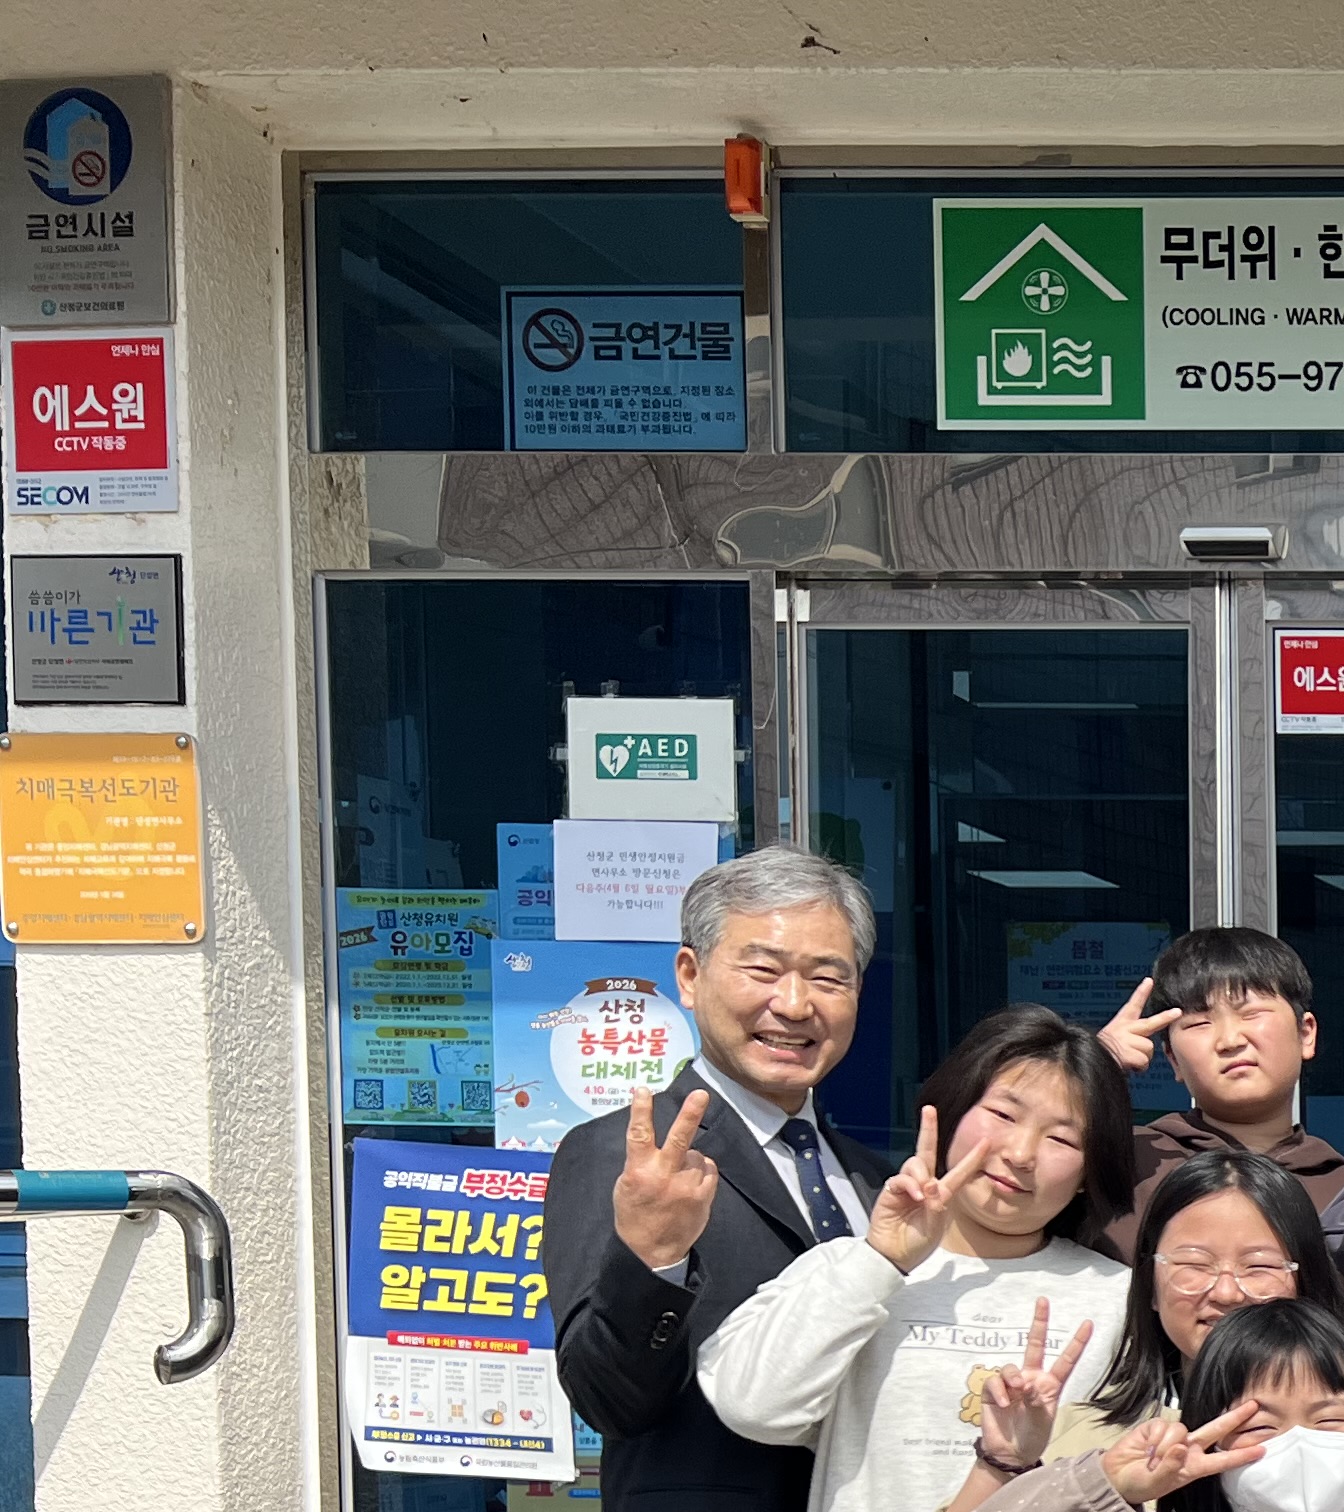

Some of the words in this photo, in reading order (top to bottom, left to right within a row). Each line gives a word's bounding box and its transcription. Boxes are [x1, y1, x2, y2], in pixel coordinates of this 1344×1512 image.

[26, 211, 135, 240] 금연시설
[1160, 226, 1276, 280] 무더위
[1161, 306, 1266, 328] (COOLING
[589, 321, 735, 361] 금연건물
[33, 382, 146, 431] 에스원
[628, 398, 638, 409] 수
[54, 437, 89, 451] CCTV
[91, 435, 127, 450] 작동중
[17, 486, 89, 506] SECOM
[28, 589, 81, 605] 씀씀이가
[28, 603, 160, 646] 바른기관
[638, 738, 689, 757] AED
[16, 777, 180, 804] 치매극복선도기관
[586, 851, 614, 862] 산청군
[400, 912, 459, 927] 산청유치원
[340, 932, 368, 946] 2026
[390, 930, 475, 957] 유아모집
[606, 980, 637, 990] 2026
[599, 998, 645, 1024] 산청
[577, 1027, 669, 1056] 농특산물
[581, 1059, 664, 1084] 대제전
[460, 1168, 550, 1201] 부정수급
[379, 1205, 544, 1260] 몰라서?
[379, 1264, 548, 1319] 알고도?
[907, 1325, 941, 1344] My
[946, 1327, 1012, 1350] Teddy
